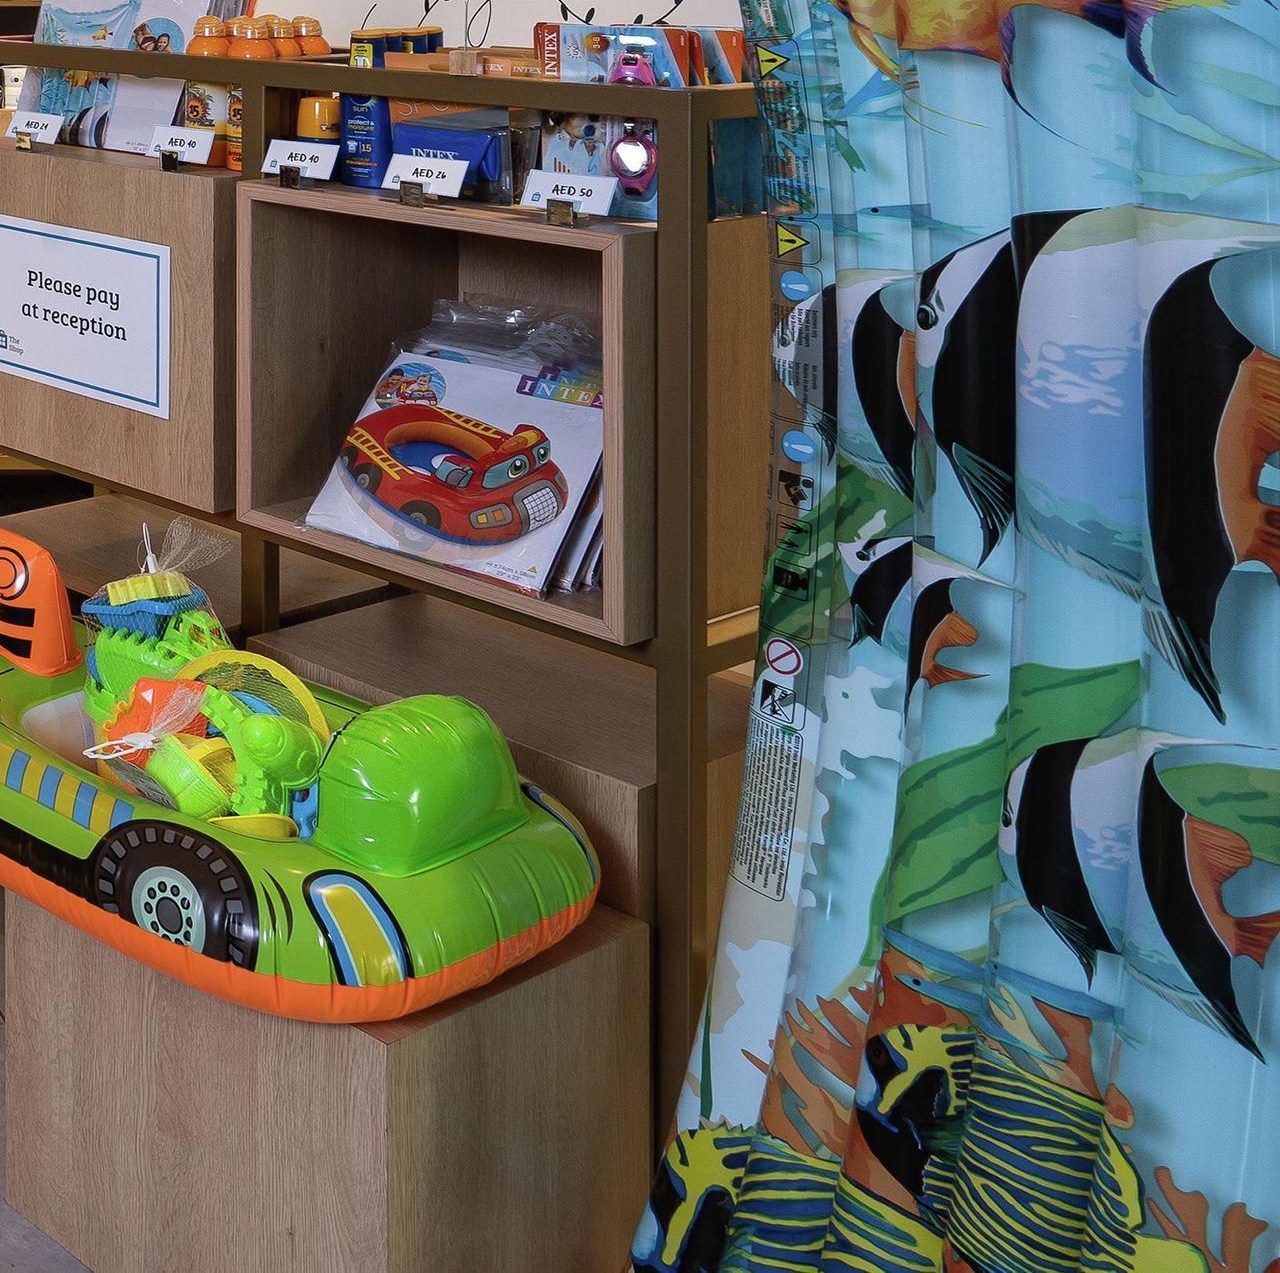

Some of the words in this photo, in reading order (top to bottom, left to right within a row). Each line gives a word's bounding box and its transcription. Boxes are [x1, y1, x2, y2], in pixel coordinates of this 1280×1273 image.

[544, 30, 558, 76] INTEX
[188, 105, 200, 117] 15
[25, 120, 39, 130] AED
[168, 137, 185, 148] AED
[361, 143, 372, 153] 15
[287, 151, 307, 162] AED
[411, 147, 459, 160] INTEX
[412, 167, 433, 179] AED
[552, 184, 576, 196] AED
[579, 186, 593, 198] 50
[27, 270, 82, 298] Please
[86, 287, 120, 311] pay
[22, 303, 39, 319] at
[43, 306, 127, 341] reception
[8, 335, 20, 345] The
[8, 343, 24, 355] Shop
